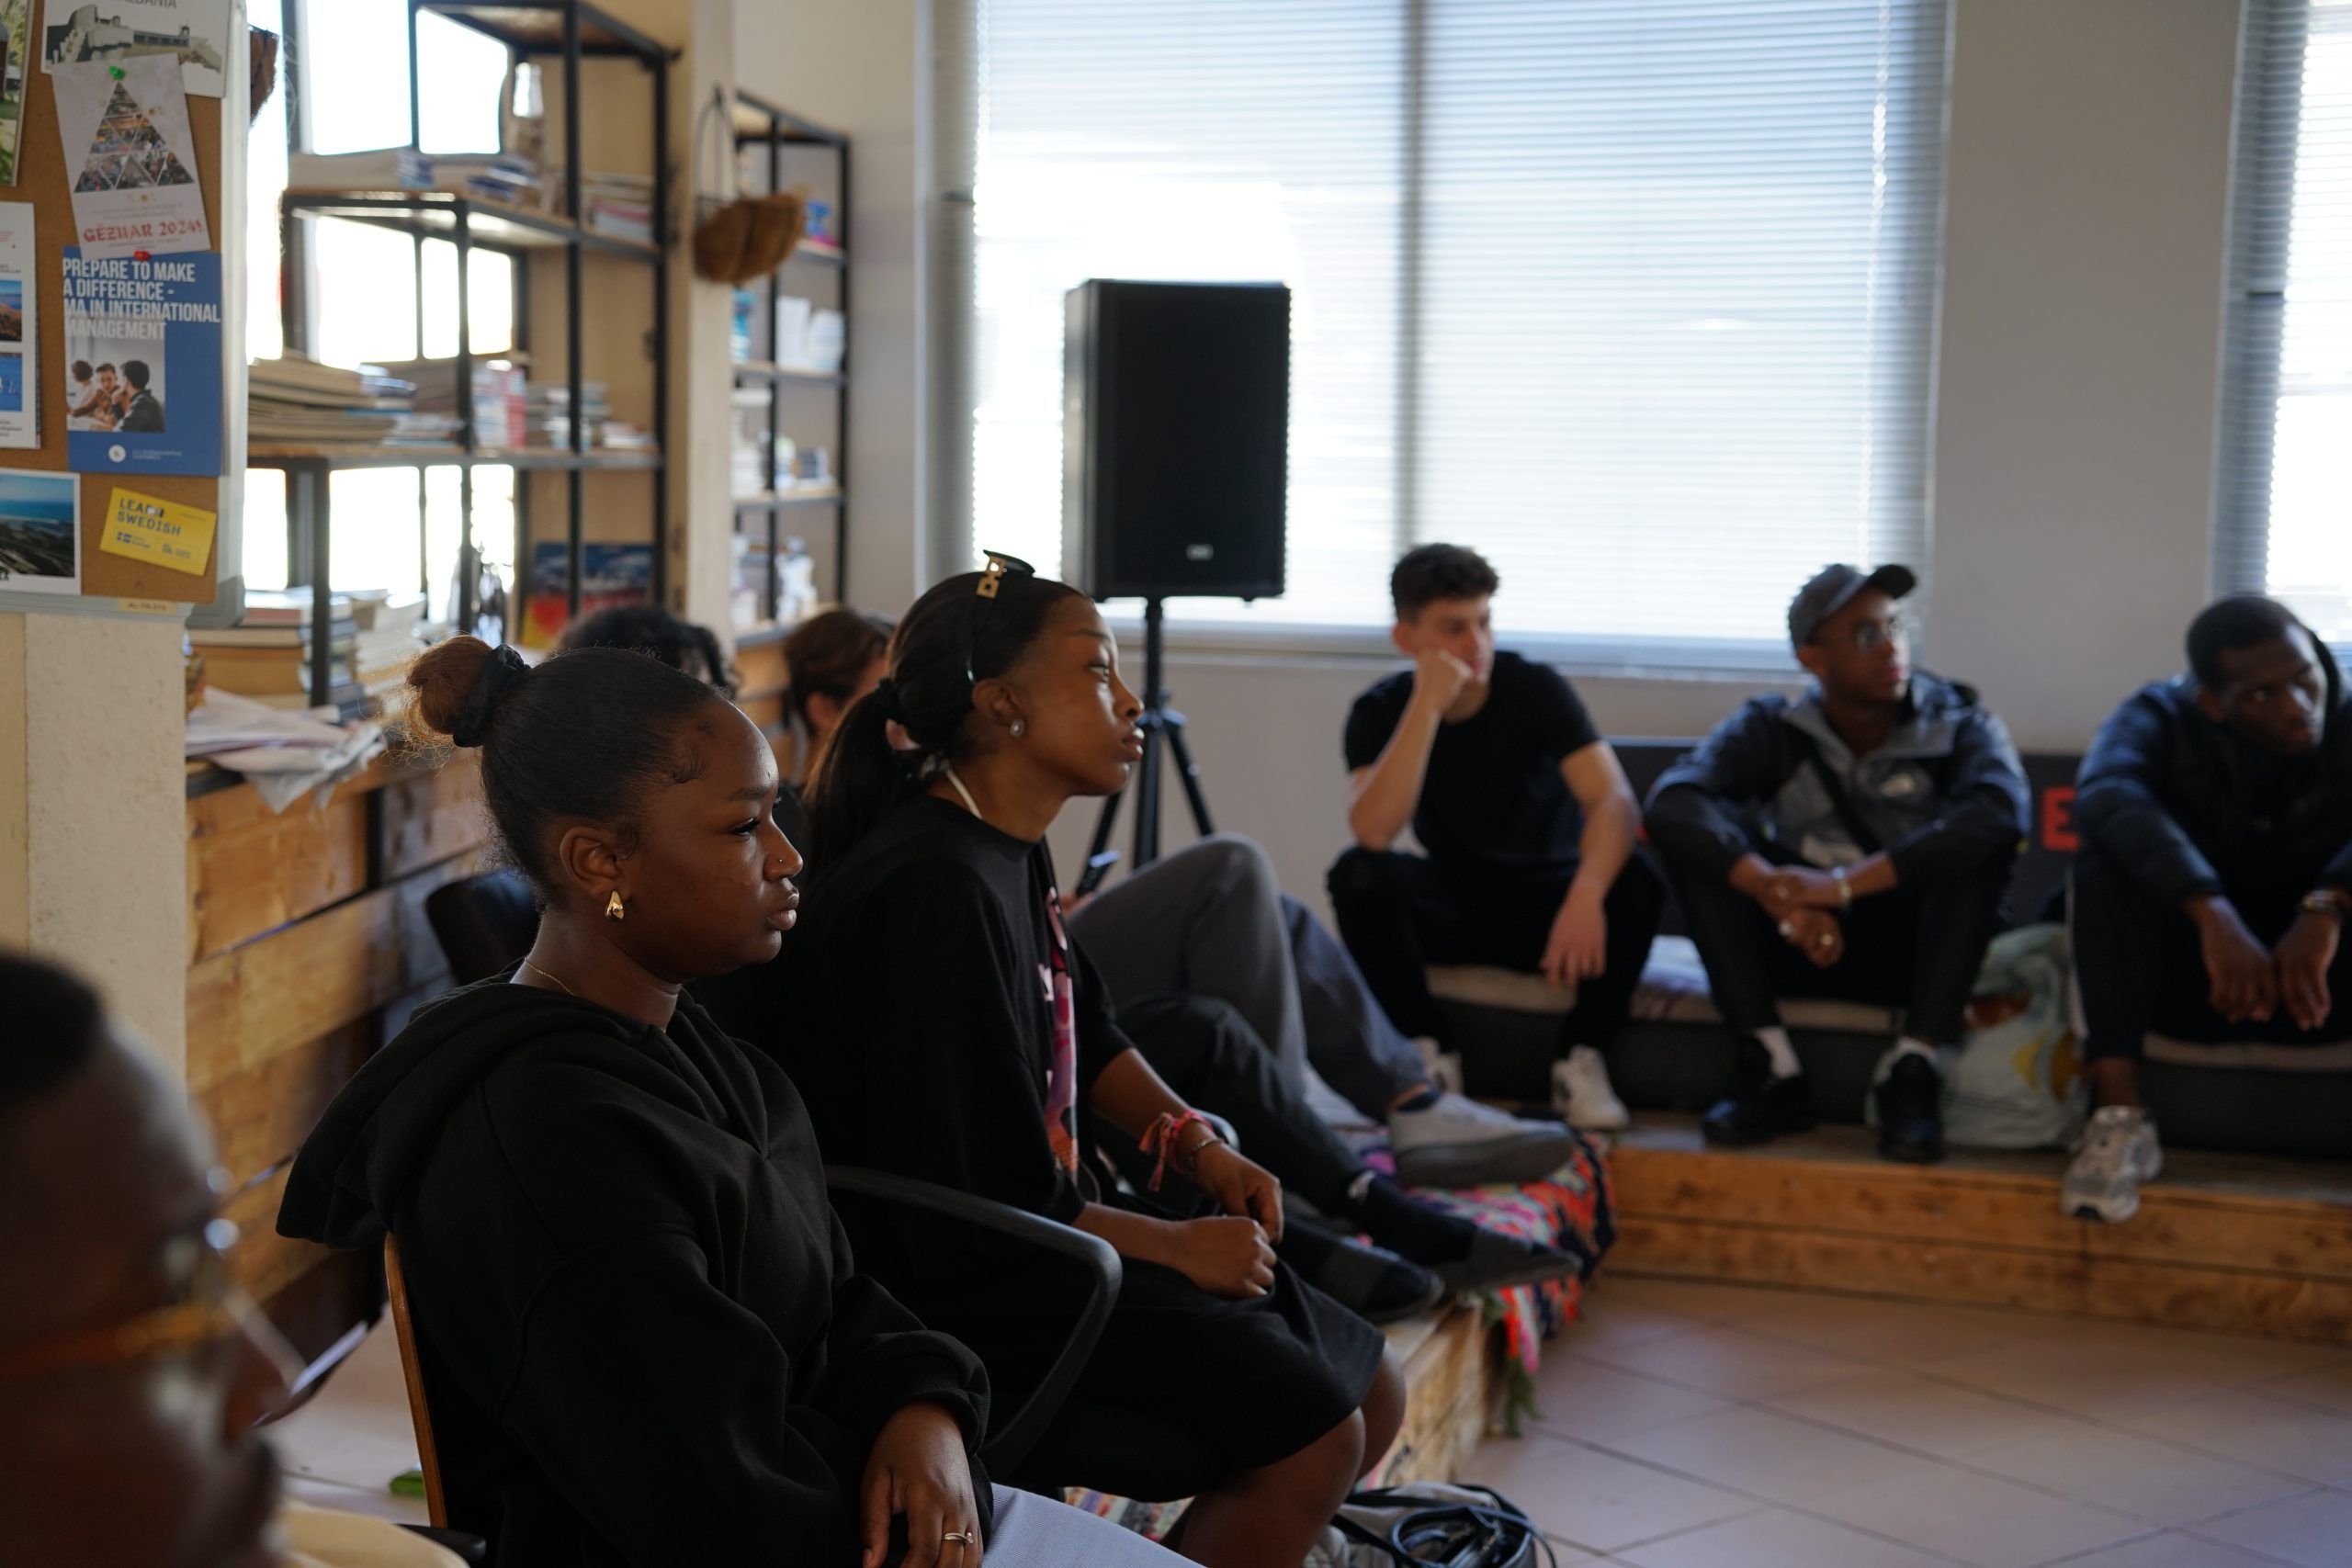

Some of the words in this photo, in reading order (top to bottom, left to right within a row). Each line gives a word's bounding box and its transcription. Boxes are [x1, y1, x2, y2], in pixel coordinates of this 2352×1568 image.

[122, 0, 176, 8] ANIA
[62, 258, 129, 278] PREPARE
[132, 261, 152, 281] TO
[153, 262, 196, 283] MAKE
[62, 279, 74, 297] A
[76, 279, 164, 300] DIFFERENCE
[63, 298, 86, 318] MA
[90, 299, 106, 319] IN
[108, 301, 220, 322] INTERNATIONAL
[65, 319, 166, 341] MANAGEMENT
[117, 511, 182, 536] SWEDISH
[2042, 786, 2080, 851] E
